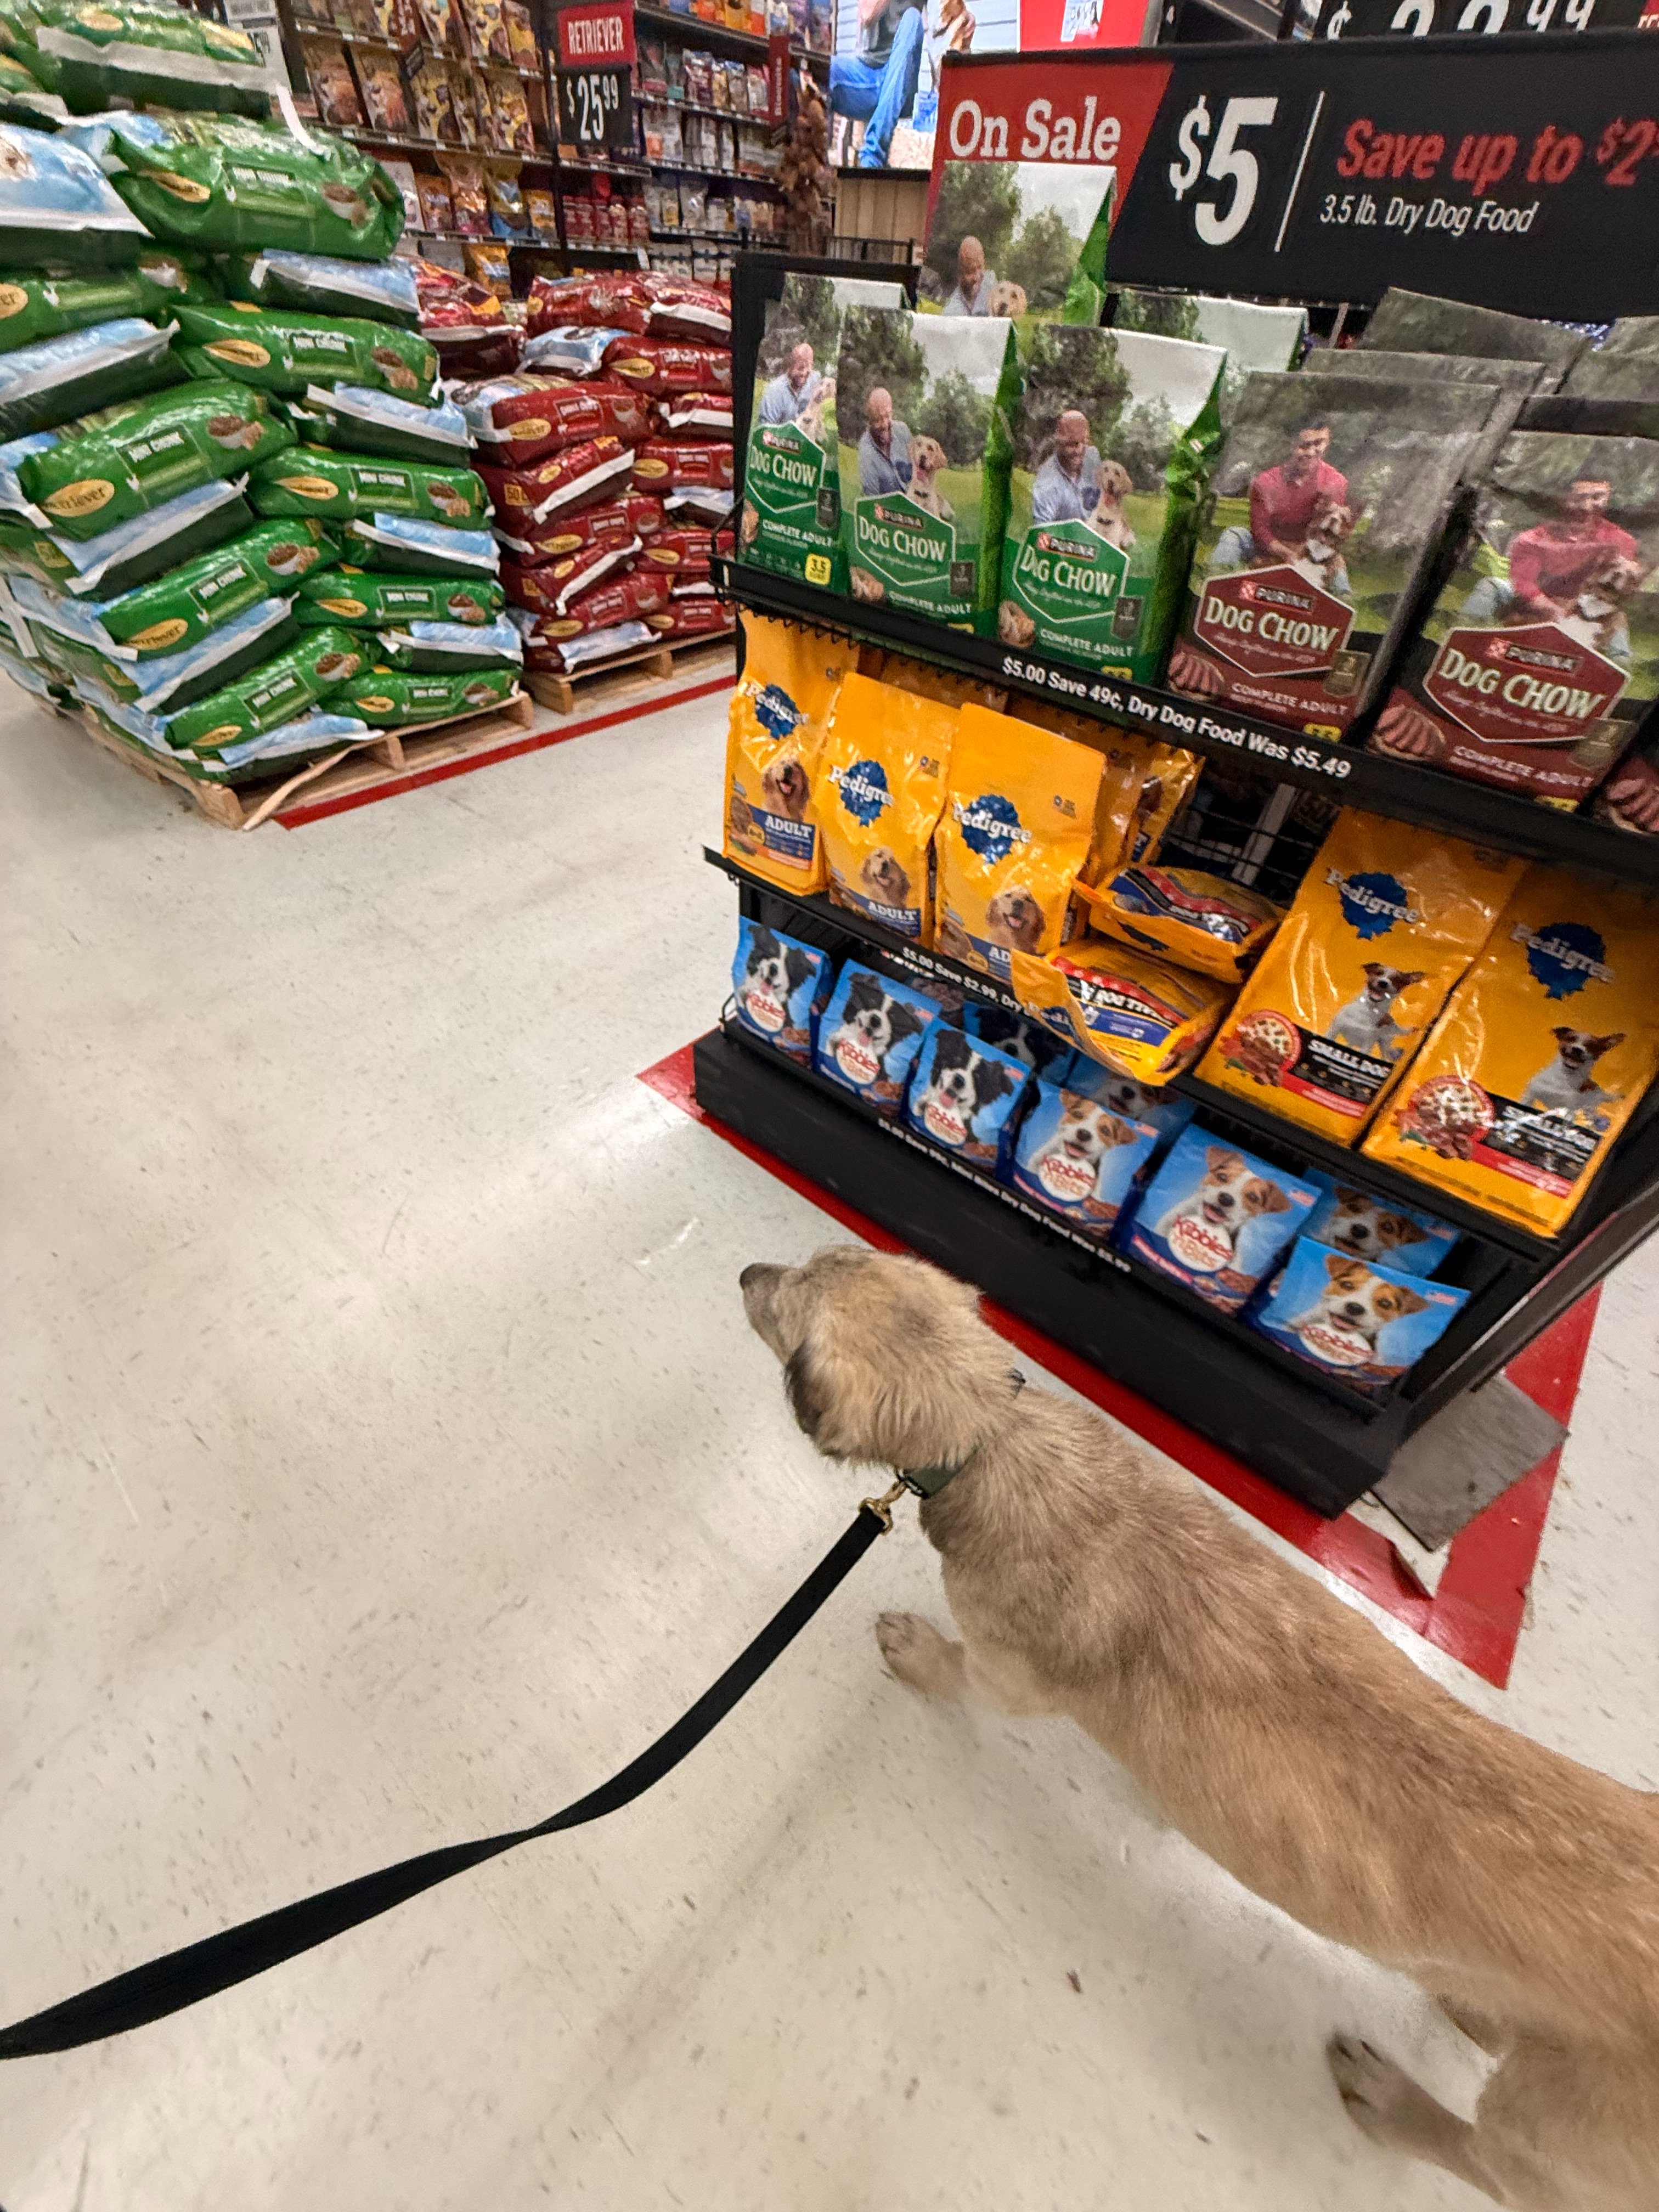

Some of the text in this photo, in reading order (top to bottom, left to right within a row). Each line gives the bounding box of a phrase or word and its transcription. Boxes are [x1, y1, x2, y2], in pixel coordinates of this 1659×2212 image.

[568, 15, 624, 55] RETRIEVER
[950, 95, 1121, 161] On Sale
[1169, 94, 1279, 246] $5
[1337, 117, 1659, 195] Save up to $2
[1321, 194, 1539, 237] 3.5 lb. Dry Dog Food
[773, 454, 817, 487] CHOW
[859, 516, 947, 562] DOG CHOW
[1054, 561, 1118, 597] CHOW
[1204, 596, 1255, 633] DOG
[1259, 612, 1339, 652] CHOW
[1438, 648, 1607, 720] DOG CHOW
[1002, 656, 1046, 685] $5.00
[1047, 672, 1087, 698] Save
[1127, 695, 1160, 721] Dry
[1160, 705, 1197, 734] Dog
[1197, 716, 1247, 747] Food
[1248, 732, 1290, 760] Was
[1291, 746, 1351, 778] $5.49
[765, 814, 813, 838] ADULT
[868, 901, 916, 922] ADULT
[1325, 867, 1420, 923] Pedigree
[902, 946, 933, 969] $5.00
[934, 963, 962, 984] Save
